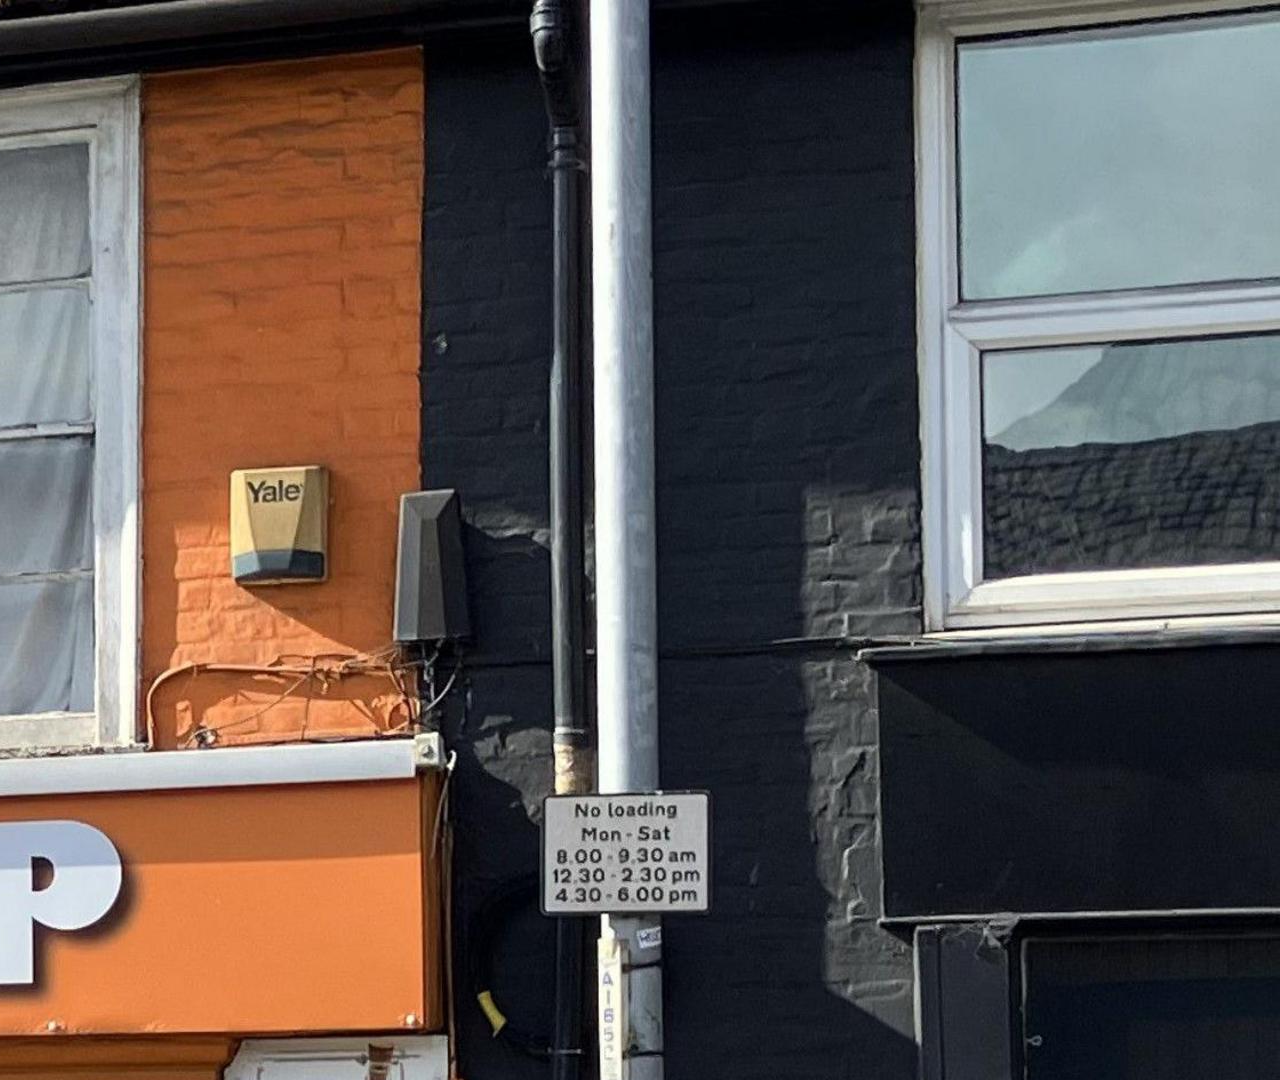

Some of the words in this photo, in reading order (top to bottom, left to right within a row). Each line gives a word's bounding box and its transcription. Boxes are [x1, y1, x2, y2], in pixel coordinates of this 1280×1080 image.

[247, 479, 300, 503] Yale
[574, 802, 601, 818] No
[608, 802, 678, 819] loading
[581, 826, 621, 842] Mon
[637, 825, 671, 841] Sat
[556, 848, 602, 865] 8.00
[618, 848, 663, 865] 9.30
[668, 850, 697, 863] am
[553, 867, 605, 884] 12.30
[621, 867, 666, 884] 2.30
[672, 869, 700, 885] pm
[555, 887, 602, 903] 4.30
[617, 886, 664, 903] 6.00
[669, 888, 698, 904] pm
